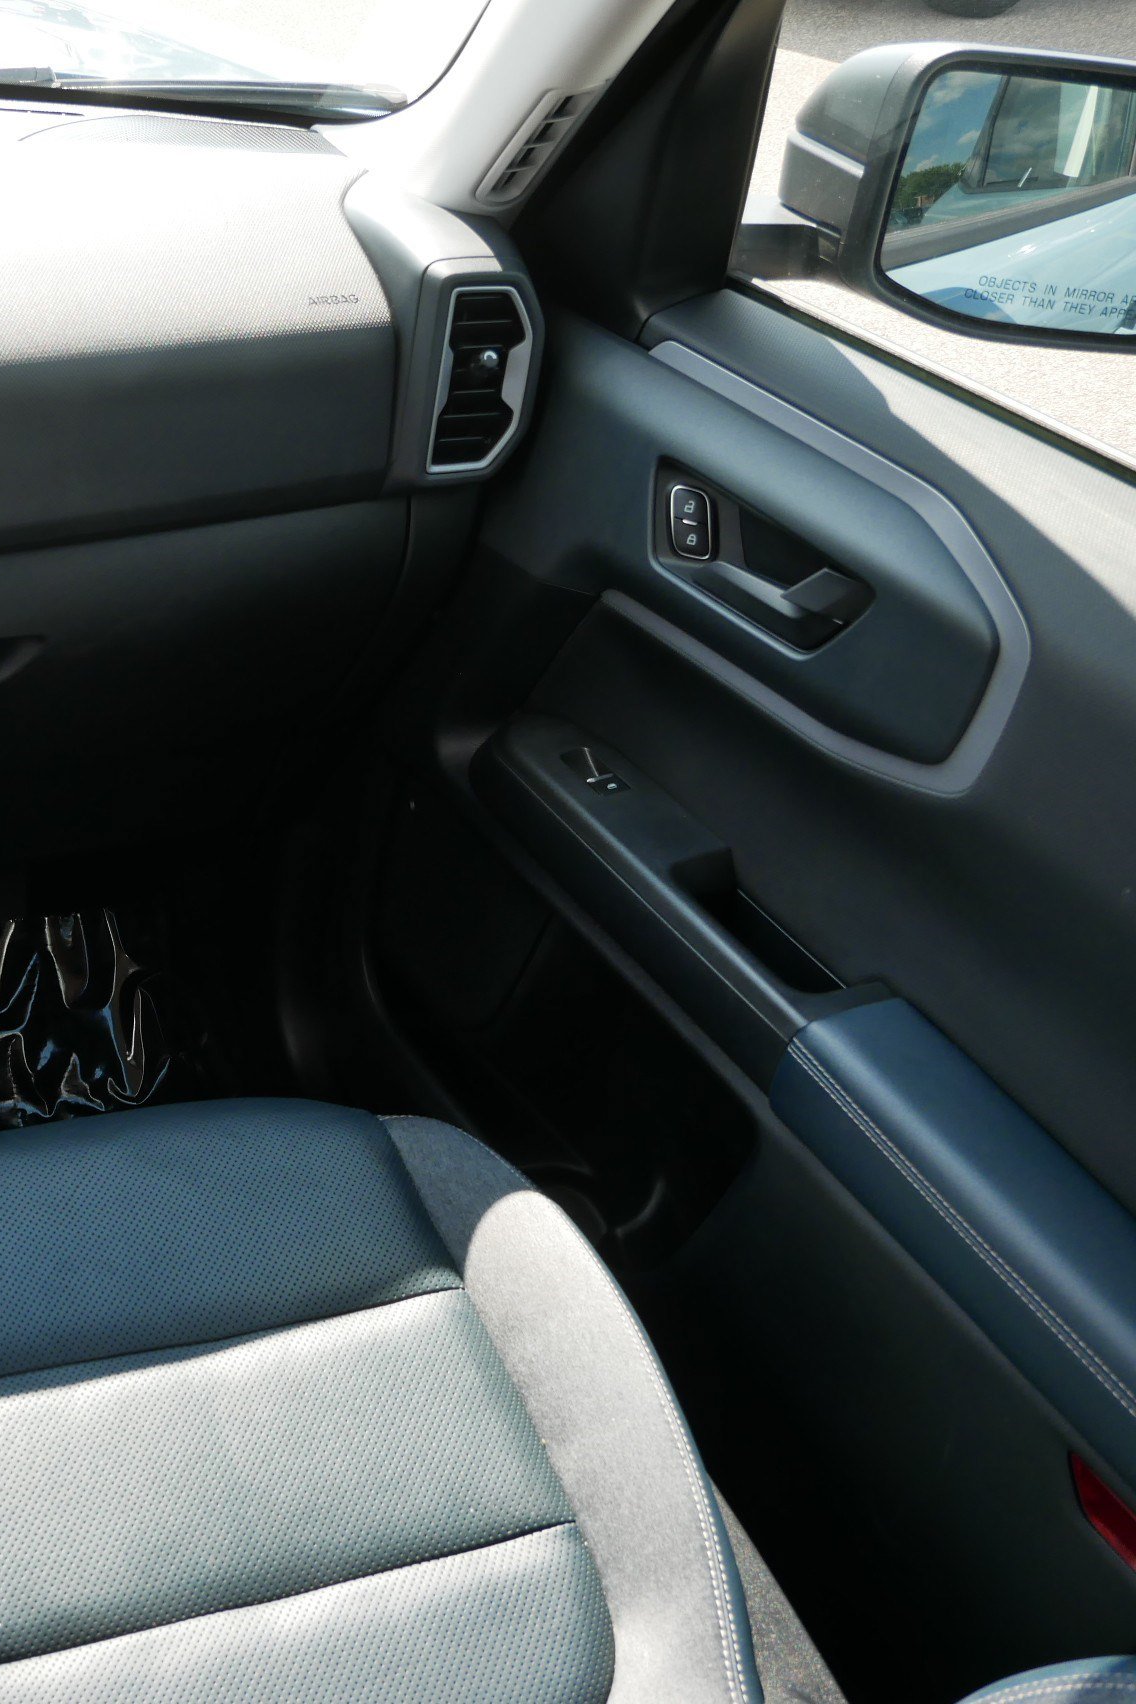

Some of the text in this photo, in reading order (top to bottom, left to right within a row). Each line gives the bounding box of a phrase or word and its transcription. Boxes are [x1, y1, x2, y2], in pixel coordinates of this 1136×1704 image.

[308, 294, 359, 306] AIRBAG
[964, 288, 1015, 304] CLOSER
[1023, 296, 1056, 310] THAN
[1063, 301, 1096, 315] THEY
[978, 275, 1037, 294] OBJECTS
[1044, 284, 1058, 296] IN
[1064, 286, 1115, 304] MIRROR
